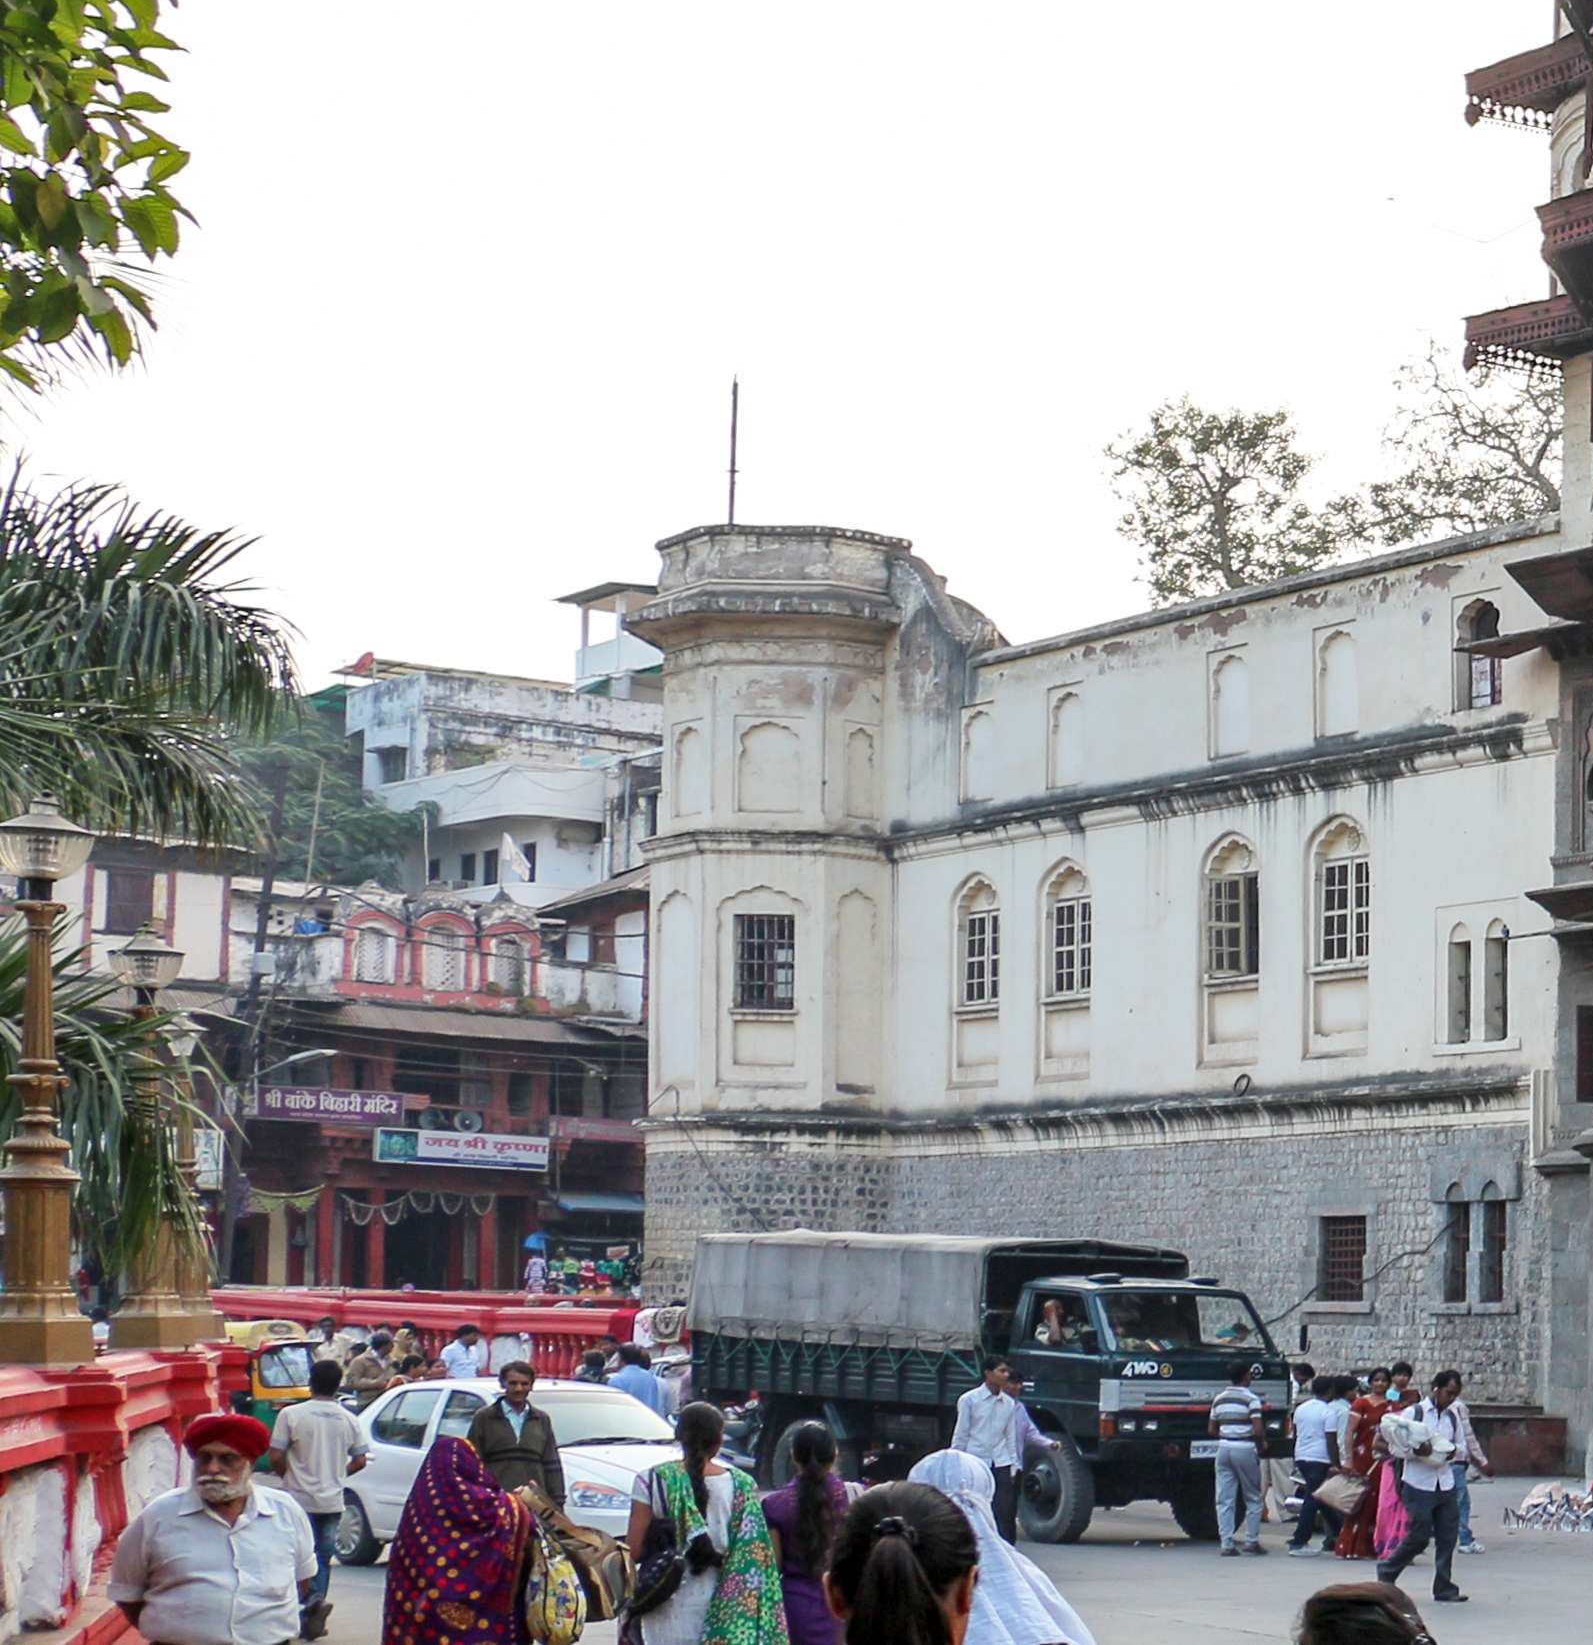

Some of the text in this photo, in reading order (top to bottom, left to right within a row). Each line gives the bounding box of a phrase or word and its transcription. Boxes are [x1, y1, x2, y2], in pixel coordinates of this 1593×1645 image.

[265, 1088, 282, 1108] श्री
[424, 1136, 460, 1149] जय
[464, 1136, 487, 1151] श्री
[1121, 1361, 1159, 1377] 4WD
